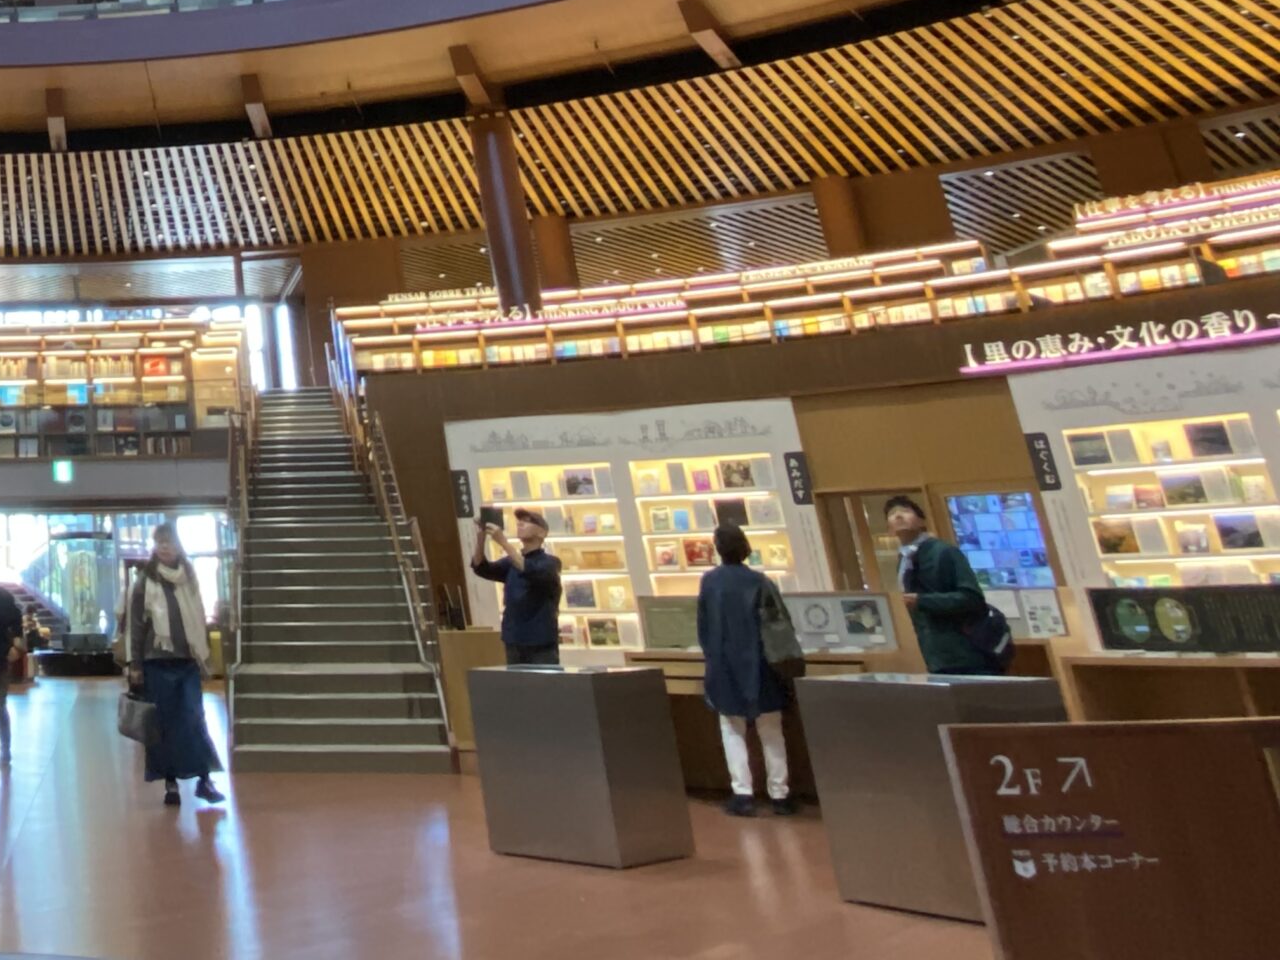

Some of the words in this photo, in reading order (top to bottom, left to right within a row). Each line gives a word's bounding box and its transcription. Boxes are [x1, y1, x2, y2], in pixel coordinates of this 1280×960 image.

[989, 753, 1043, 796] 2F
[1041, 850, 1160, 874] 予約本コーナー
